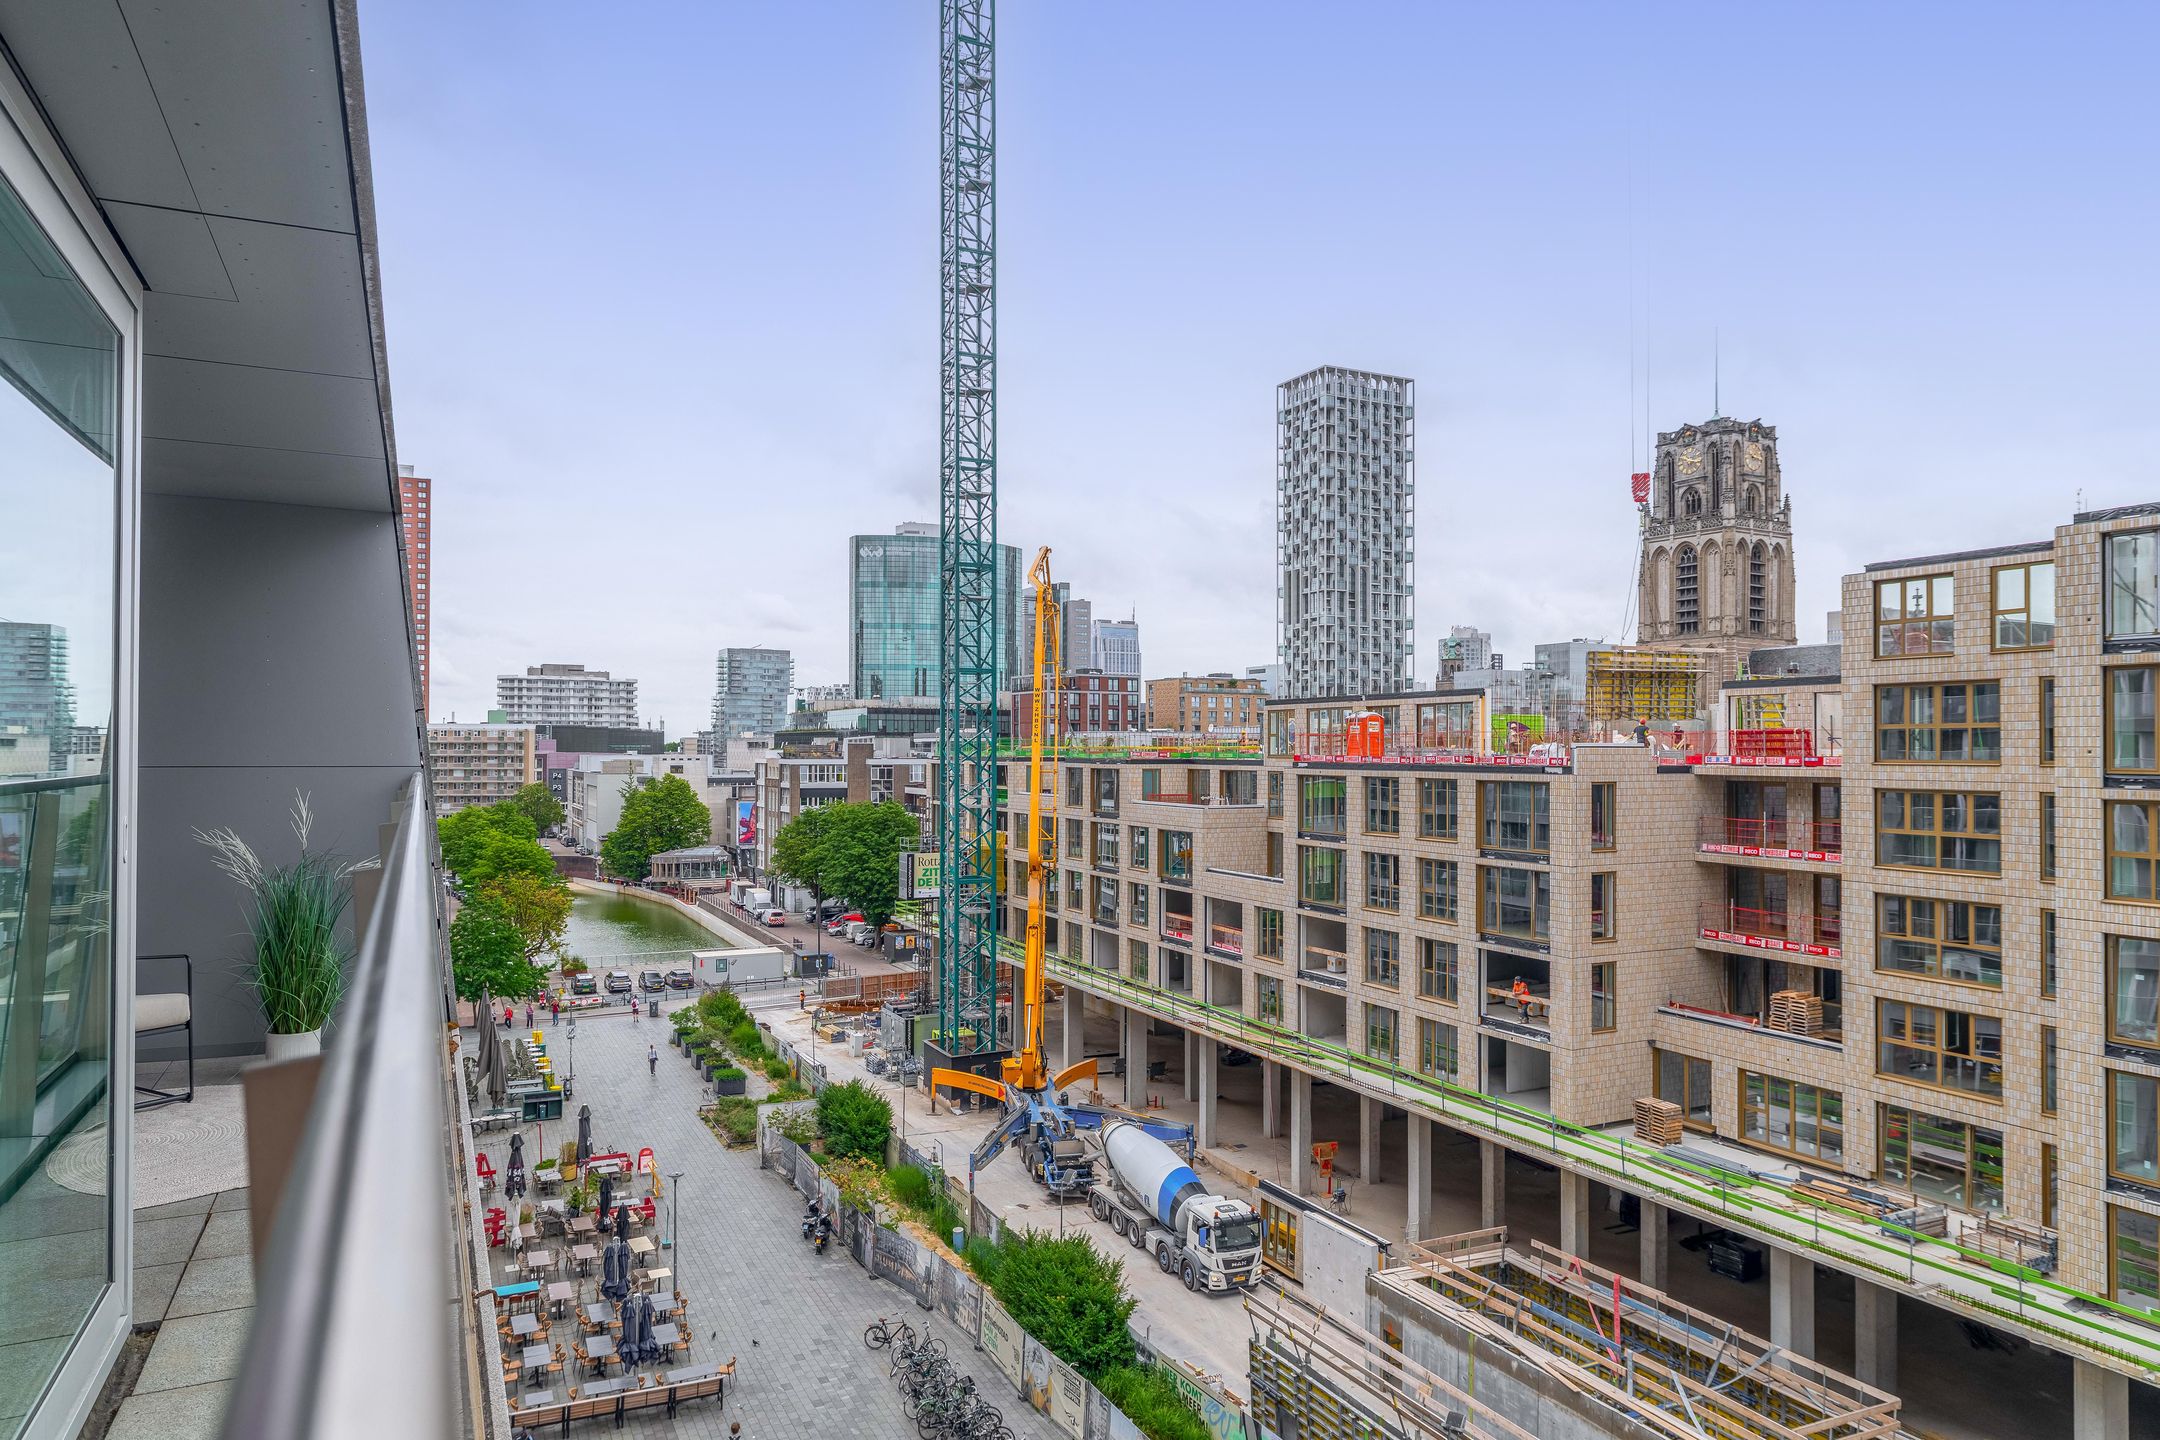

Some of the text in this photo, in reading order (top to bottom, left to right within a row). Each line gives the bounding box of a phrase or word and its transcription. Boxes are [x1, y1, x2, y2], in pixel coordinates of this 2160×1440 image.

[922, 868, 940, 877] ZIT
[918, 878, 933, 887] DE
[1181, 1379, 1203, 1403] KOMT
